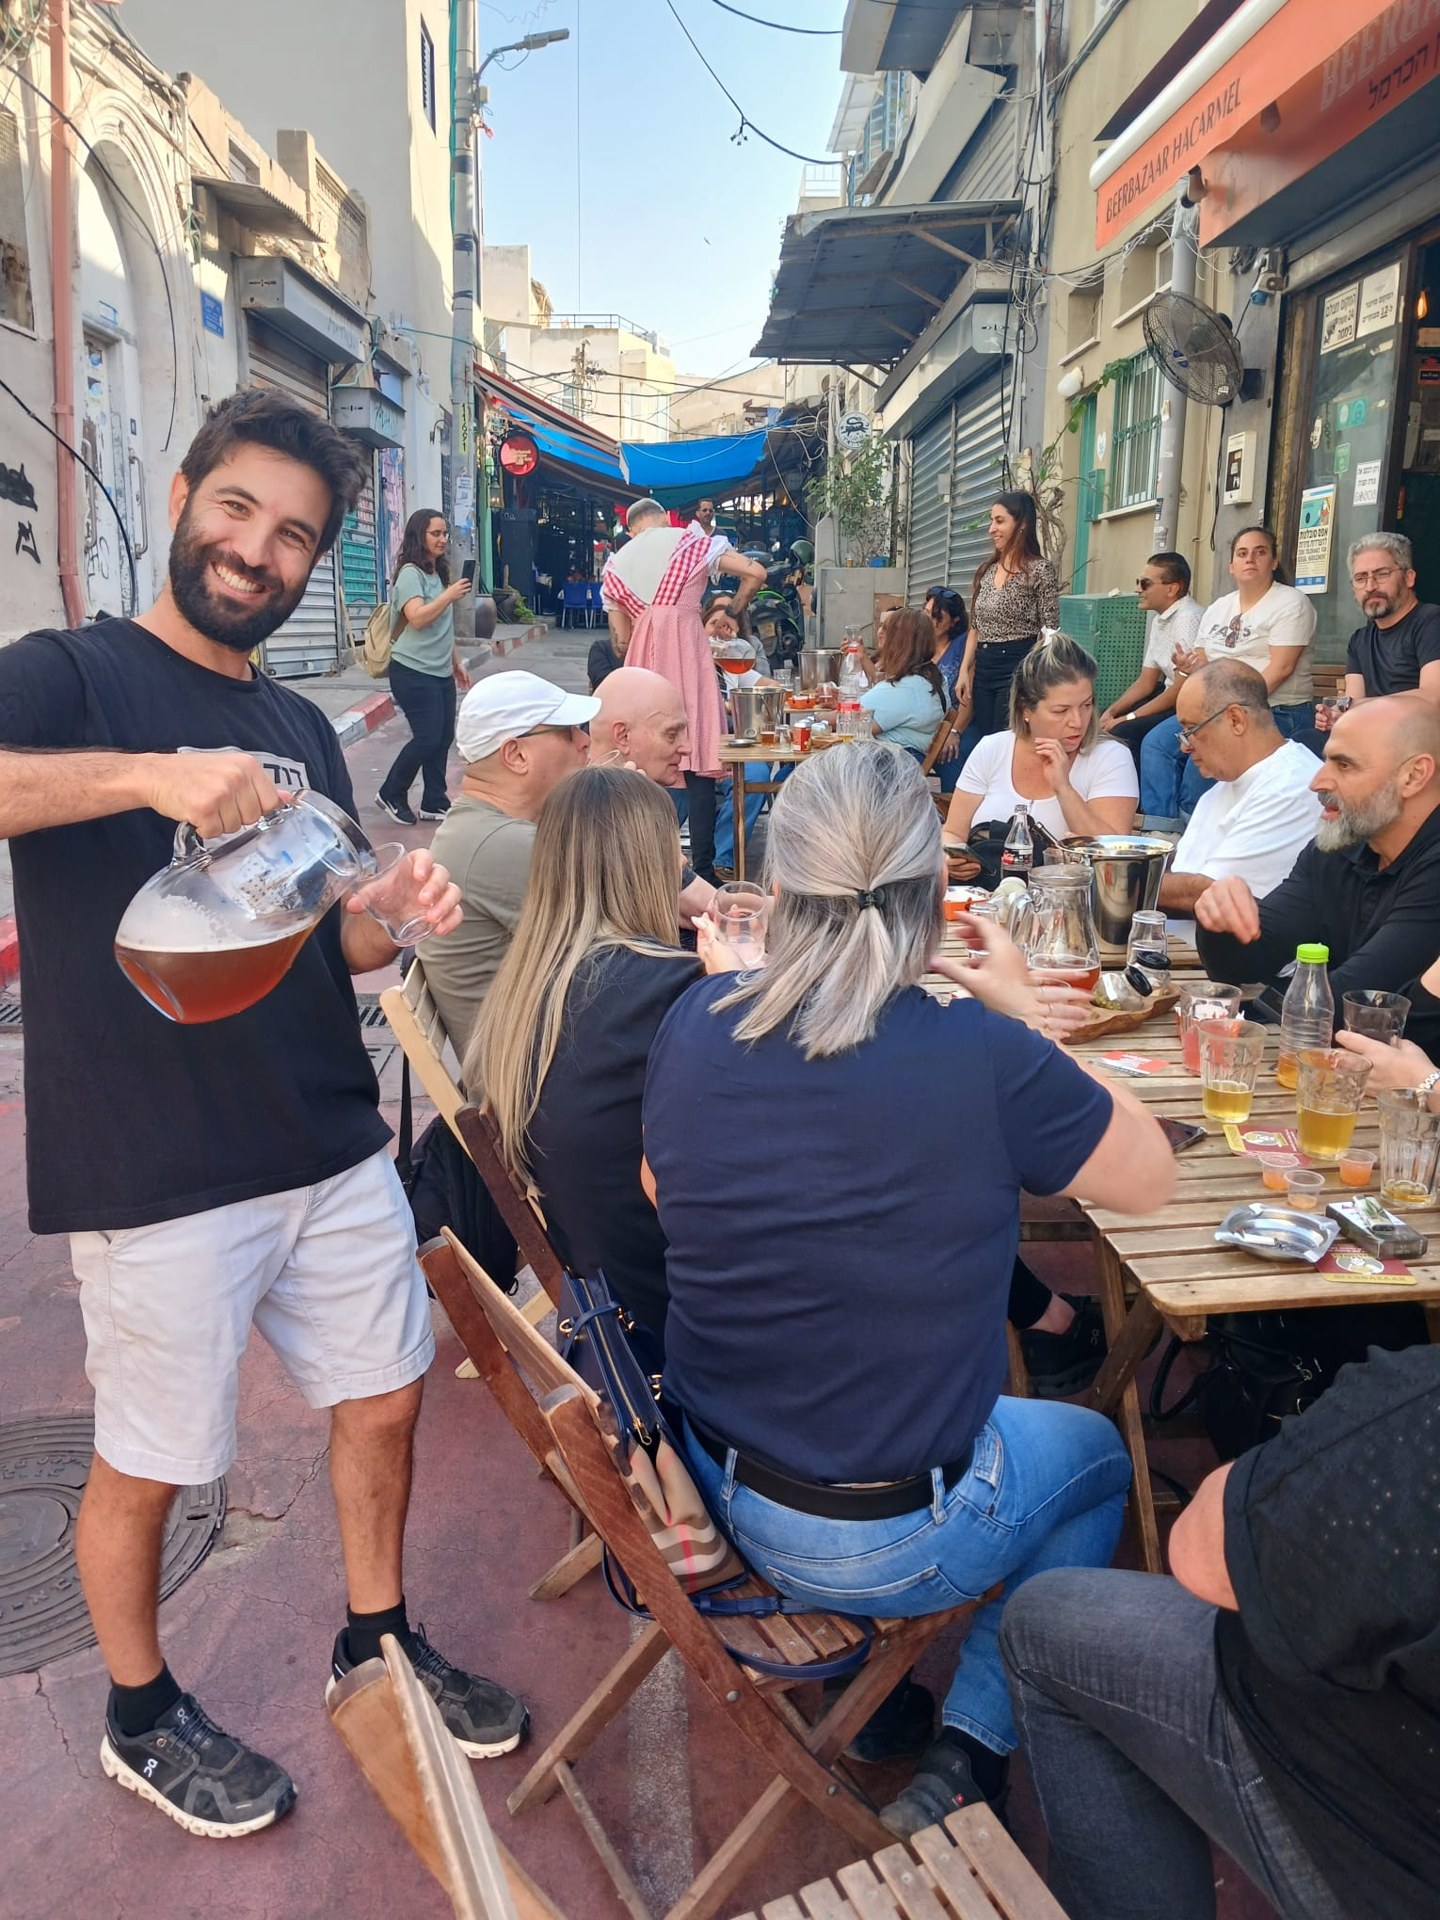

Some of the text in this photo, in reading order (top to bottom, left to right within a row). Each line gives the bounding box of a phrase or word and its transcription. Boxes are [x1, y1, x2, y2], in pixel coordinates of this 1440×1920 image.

[1368, 43, 1429, 111] הכרמל
[1106, 77, 1241, 223] BEERBAZAAR HACARMEL
